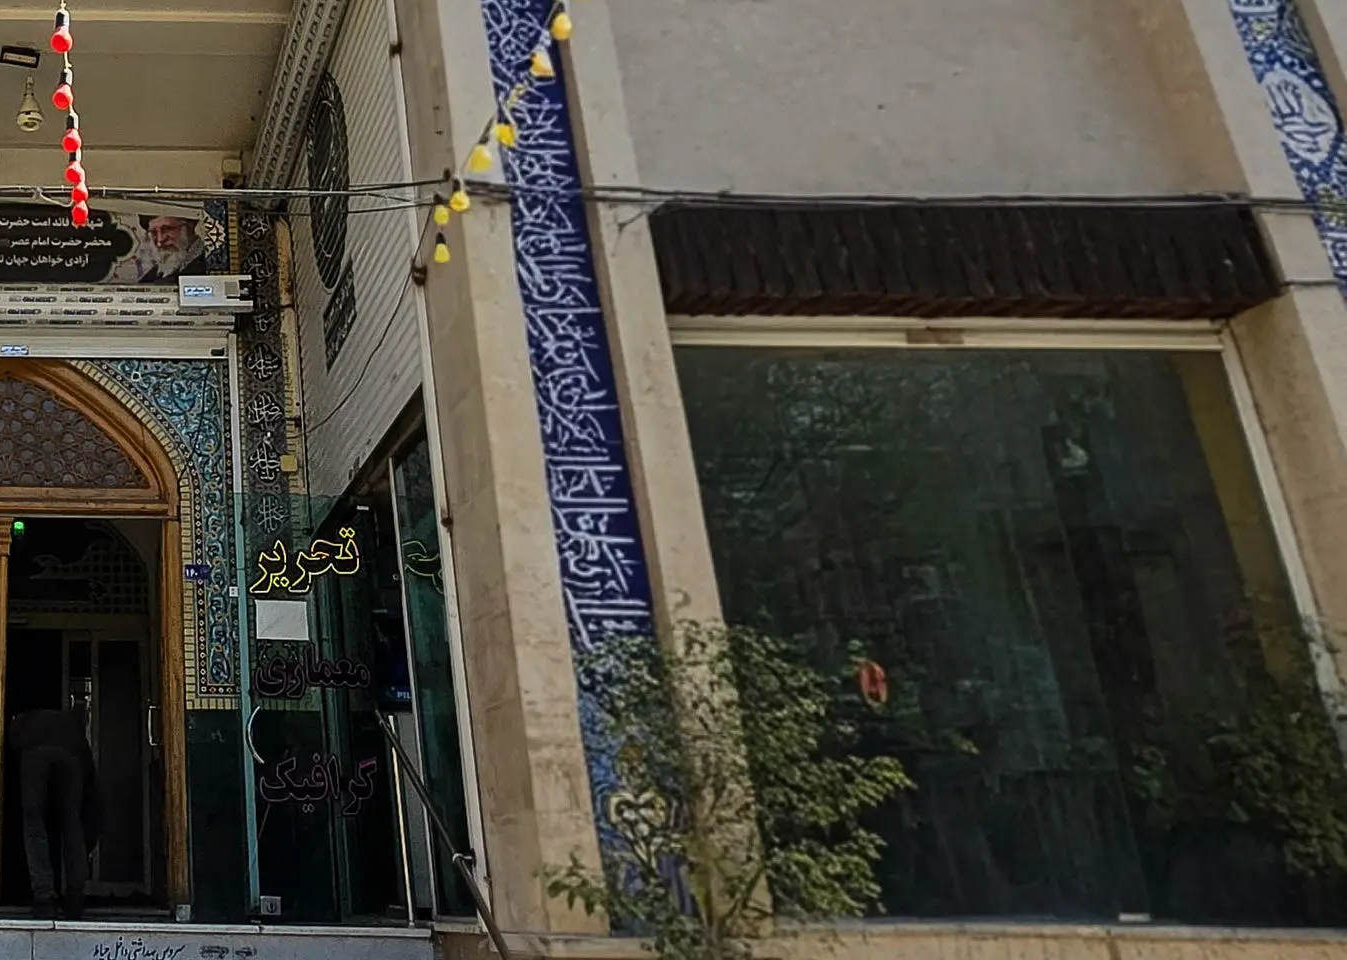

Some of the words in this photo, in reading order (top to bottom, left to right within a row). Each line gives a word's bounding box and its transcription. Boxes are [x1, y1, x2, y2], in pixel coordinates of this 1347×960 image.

[0, 217, 30, 230] حضرت
[31, 236, 50, 250] امام
[51, 236, 82, 249] حضرت
[83, 237, 112, 249] محضر
[5, 253, 29, 267] جهان
[30, 254, 63, 267] خواهان
[249, 527, 360, 594] تحریر
[254, 643, 372, 698] معماری
[259, 754, 378, 816] گرافیک
